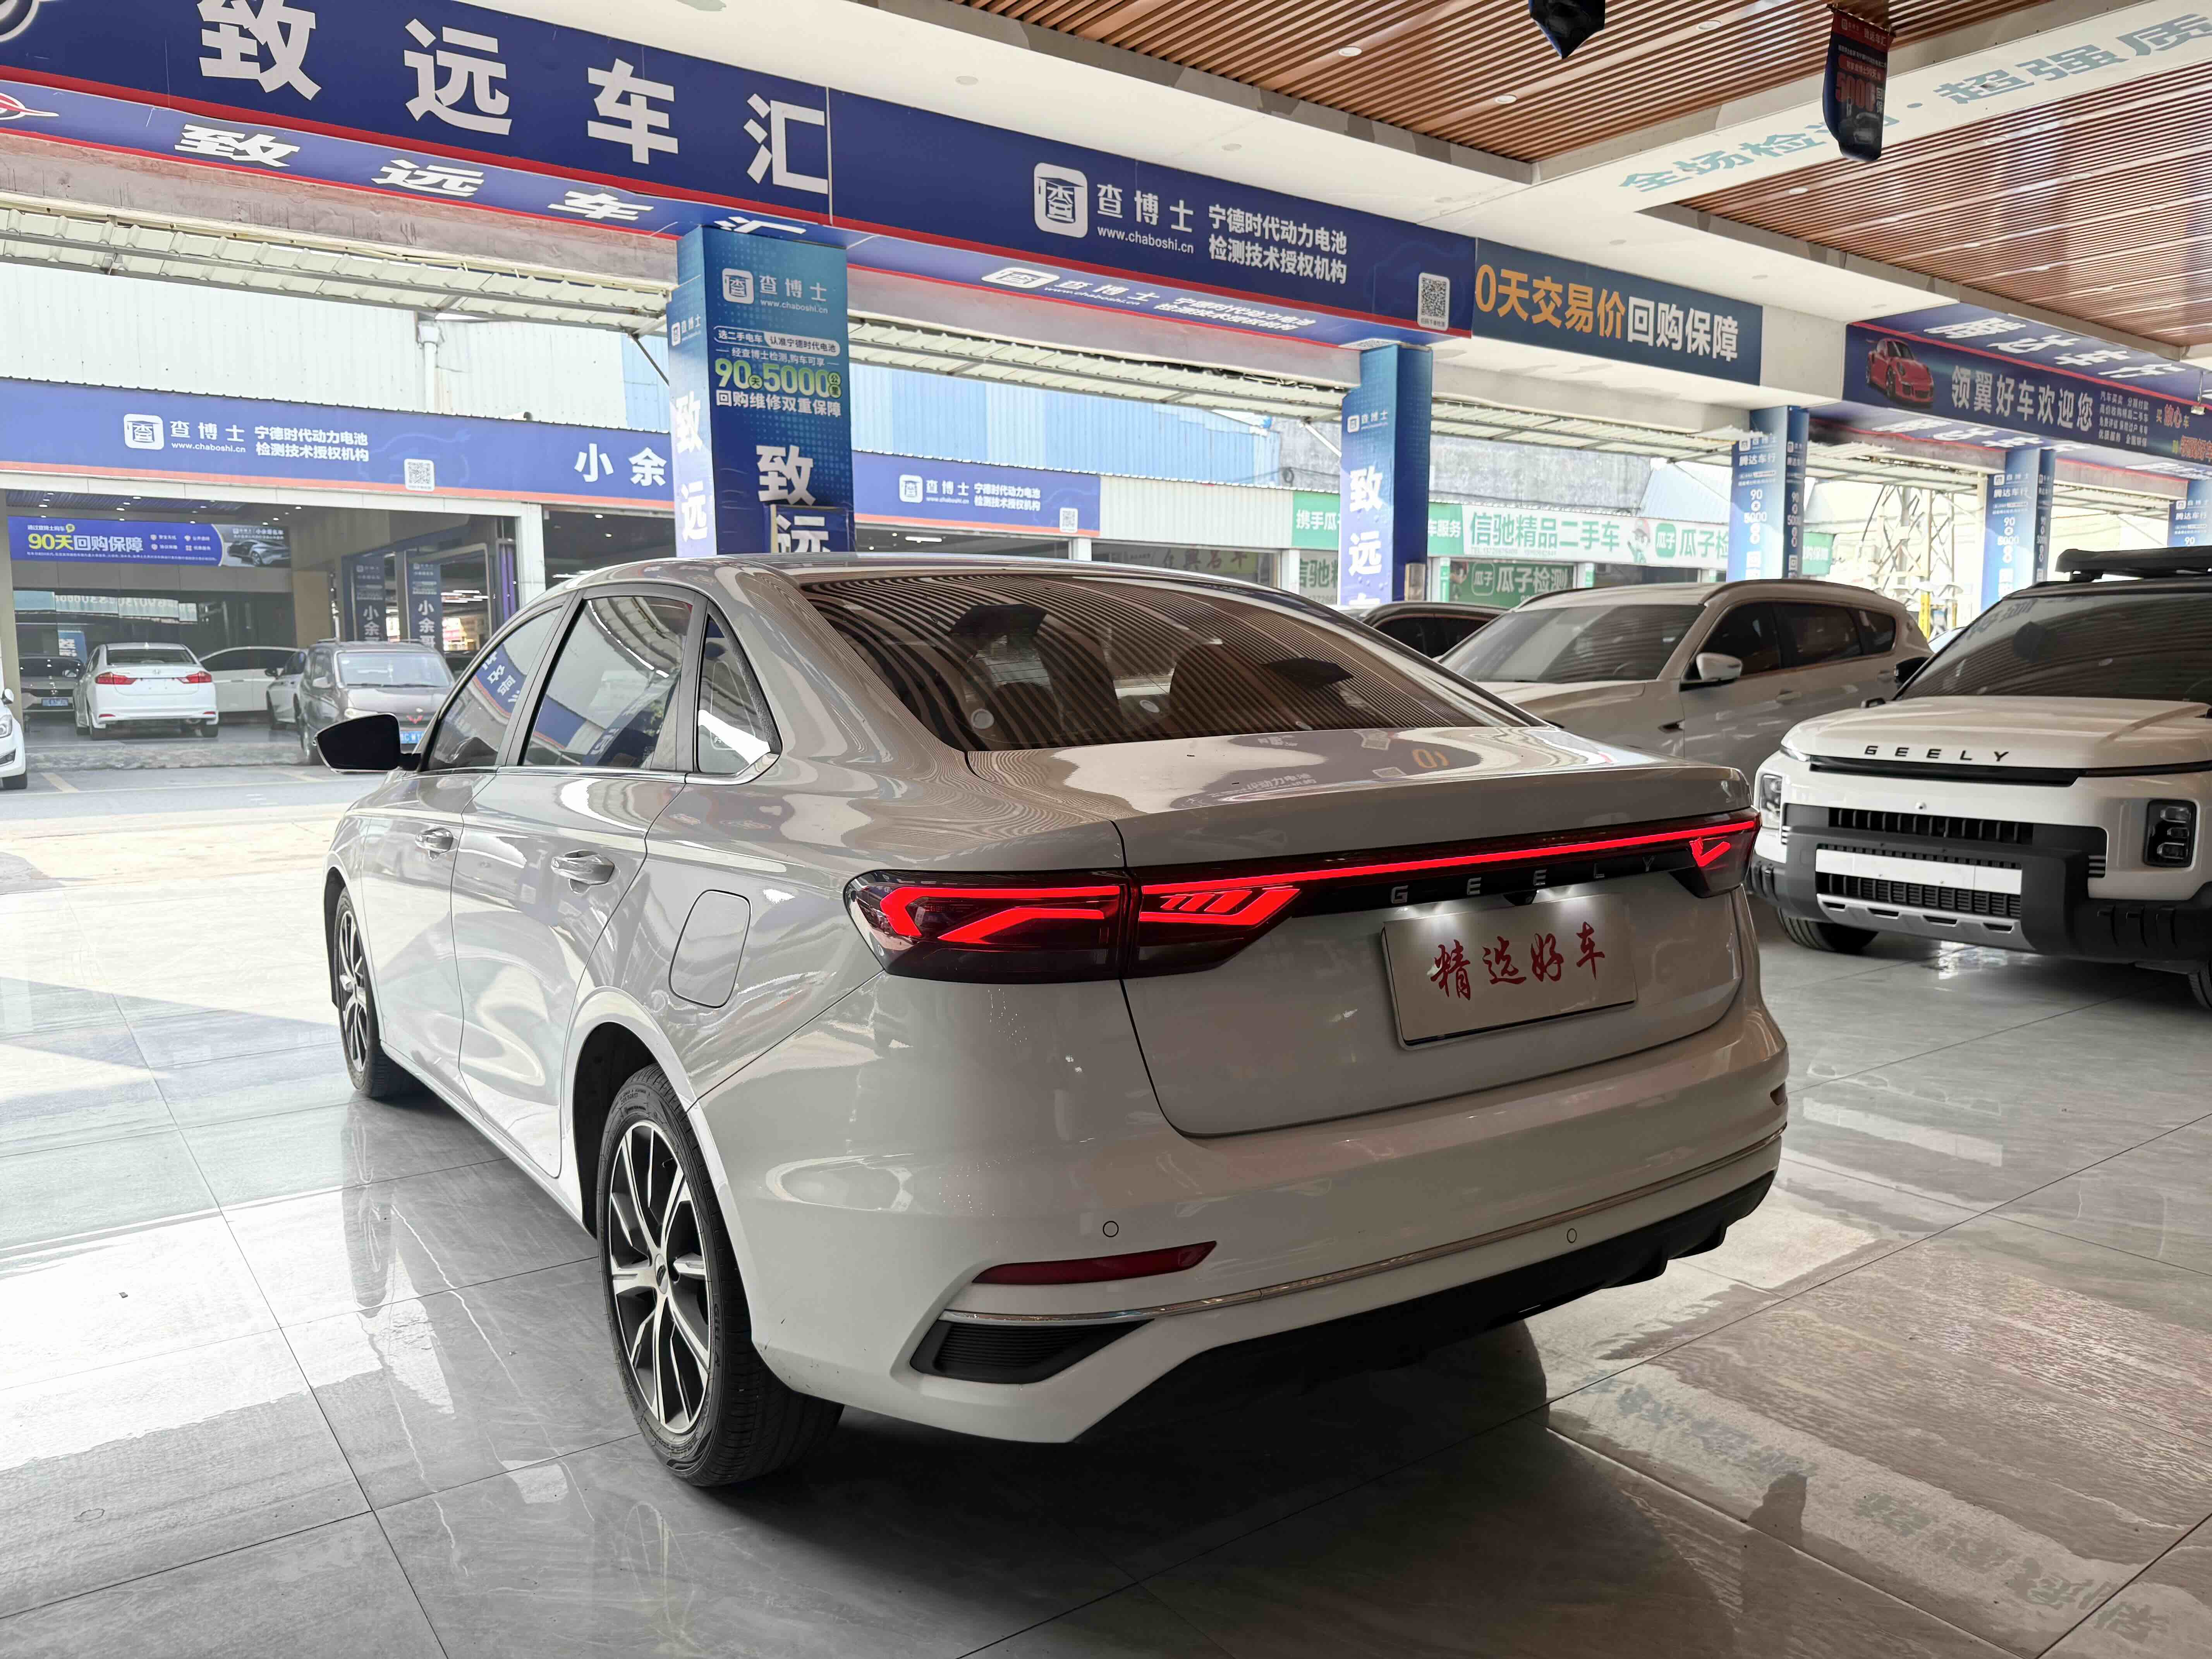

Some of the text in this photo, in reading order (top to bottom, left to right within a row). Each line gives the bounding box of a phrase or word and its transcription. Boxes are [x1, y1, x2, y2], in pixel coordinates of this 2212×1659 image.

[197, 0, 829, 195] 致远车汇
[1097, 184, 1194, 232] 查博士
[1097, 226, 1194, 254] www.chaboshi.cn
[1208, 204, 1347, 256] 宁德时代动力电池
[1208, 235, 1347, 285] 检测技术授权机构
[759, 275, 827, 302] 查博士
[1054, 280, 1160, 302] 查博士
[761, 299, 828, 314] www.chaboshi.cn
[718, 330, 763, 343] 选二手电车
[769, 335, 836, 353] 认准宁德时代电池
[716, 389, 842, 417] 回购维修双重保障
[1952, 364, 2093, 432] 领翼好车欢迎您
[170, 421, 245, 443] 查博士
[254, 425, 368, 447] 宁德时代动力电池
[172, 441, 246, 453] www.chaboshi.cn
[255, 442, 369, 462] 检测技术授权机构
[574, 443, 667, 486] 小余
[926, 480, 969, 496] 查博士
[974, 483, 1041, 499] 宁德时代动力电池
[1750, 489, 1763, 500] 90
[974, 497, 1041, 512] 检测技术授权机构
[1295, 510, 1340, 530] 携手瓜
[28, 533, 144, 553] 90天回购保障
[1348, 465, 1383, 604] 致远
[1470, 512, 1620, 552] 信驰精品二手车
[1864, 745, 2009, 762] GEELY
[1391, 854, 1657, 904] GEELY
[1430, 921, 1606, 1001] 精选好车
